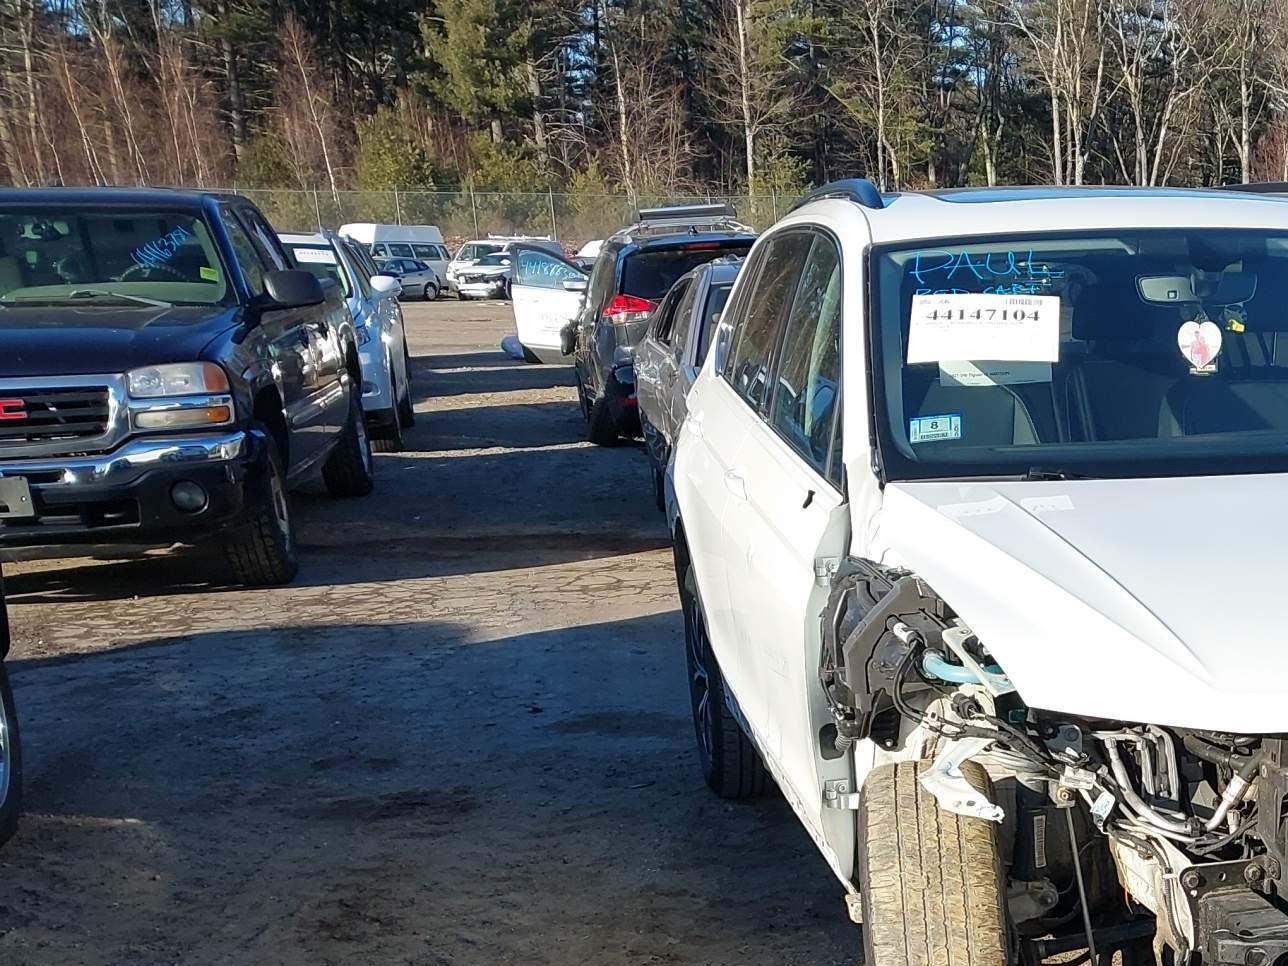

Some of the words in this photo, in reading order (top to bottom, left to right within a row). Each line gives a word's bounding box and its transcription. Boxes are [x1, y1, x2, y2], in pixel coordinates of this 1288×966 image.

[904, 248, 1065, 284] PAUL
[926, 308, 1041, 322] 44147104
[930, 421, 939, 430] 8
